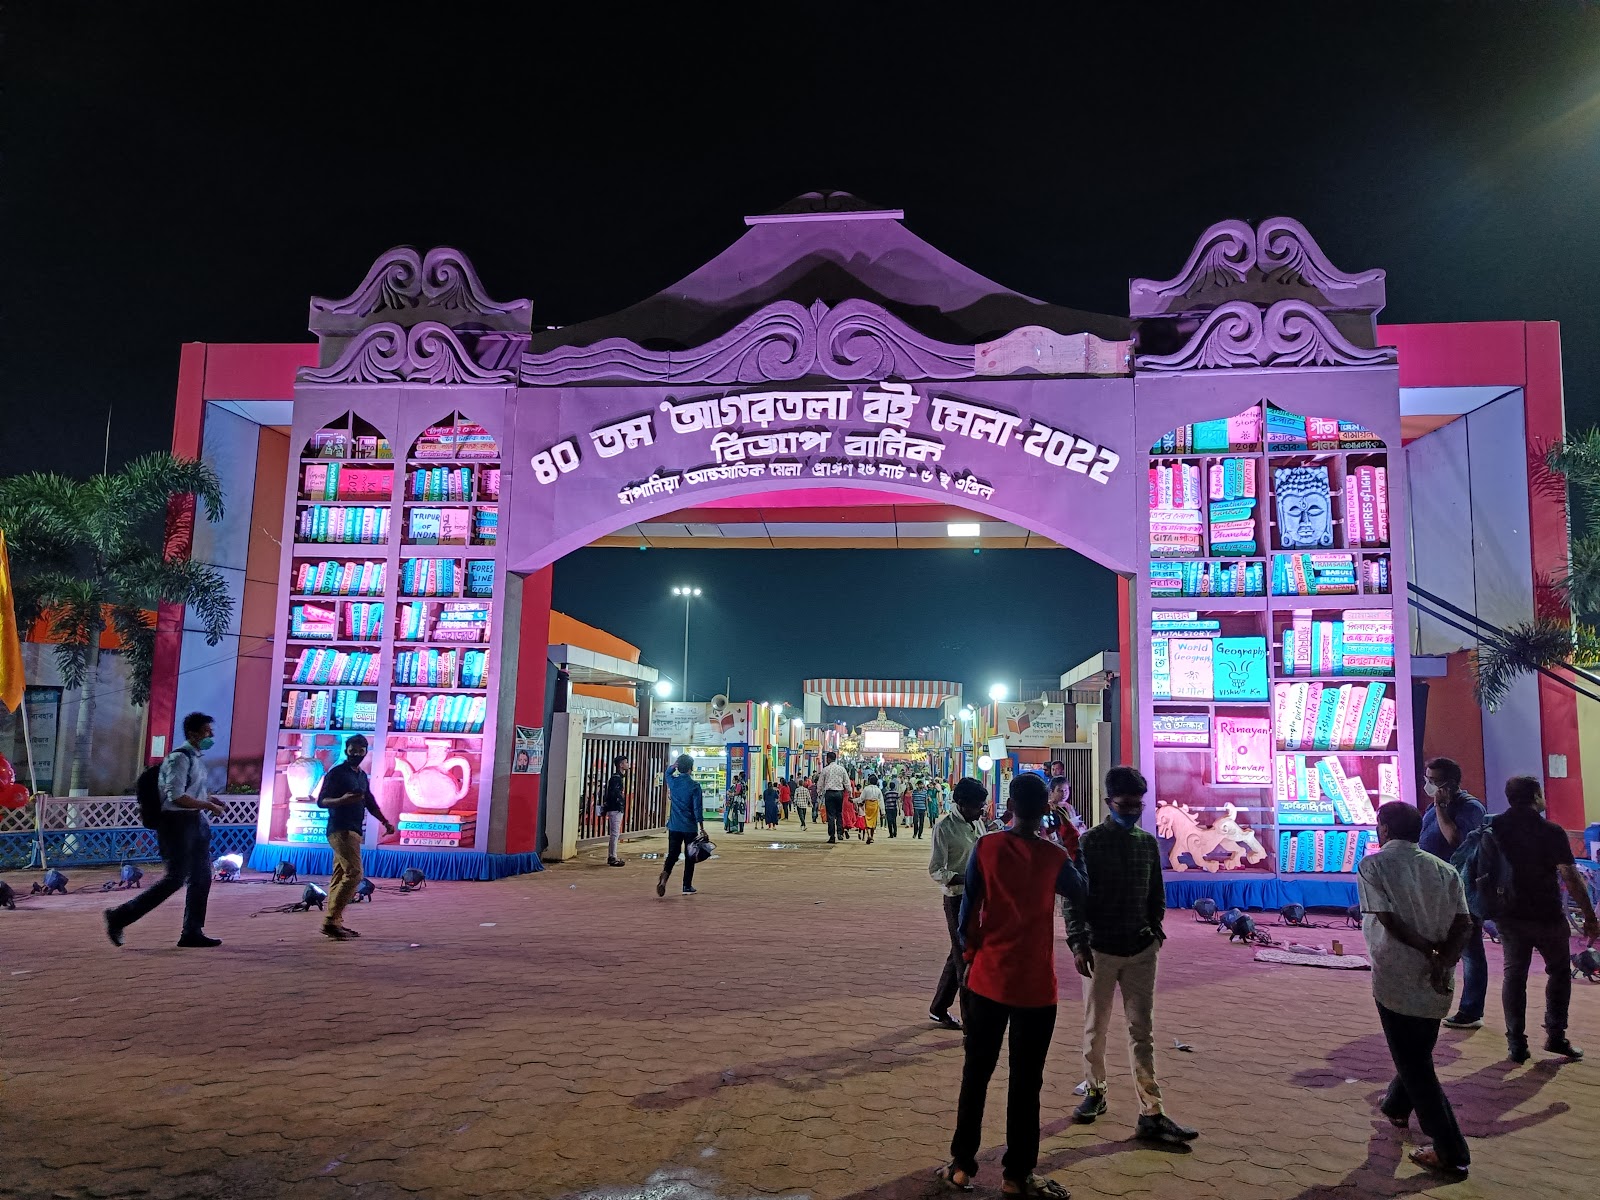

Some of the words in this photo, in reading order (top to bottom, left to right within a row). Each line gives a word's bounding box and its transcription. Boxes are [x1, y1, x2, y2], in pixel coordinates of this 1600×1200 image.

[589, 414, 655, 459] তম
[660, 391, 852, 434] আগরতলা
[863, 381, 920, 428] বই
[1310, 417, 1338, 435] গীতা
[769, 463, 802, 477] মেলা
[955, 476, 995, 500] এপ্রিল
[1361, 468, 1371, 492] LIGHT
[1379, 485, 1387, 504] LAW
[413, 531, 437, 540] INDIA
[1363, 502, 1376, 542] EMPIRES
[1153, 534, 1173, 542] GITA
[323, 576, 332, 591] JOY
[328, 561, 337, 577] RAM
[1178, 643, 1209, 652] World
[1216, 642, 1265, 660] Geography
[335, 689, 346, 723] HOCKEY
[1278, 764, 1286, 796] IDIOMS
[1308, 769, 1317, 799] PHRASES
[406, 831, 452, 839] ASTRONOMY
[1346, 833, 1357, 865] SOLAPUR
[1326, 835, 1335, 866] RAMPUR
[1335, 837, 1345, 866] SAMPUR
